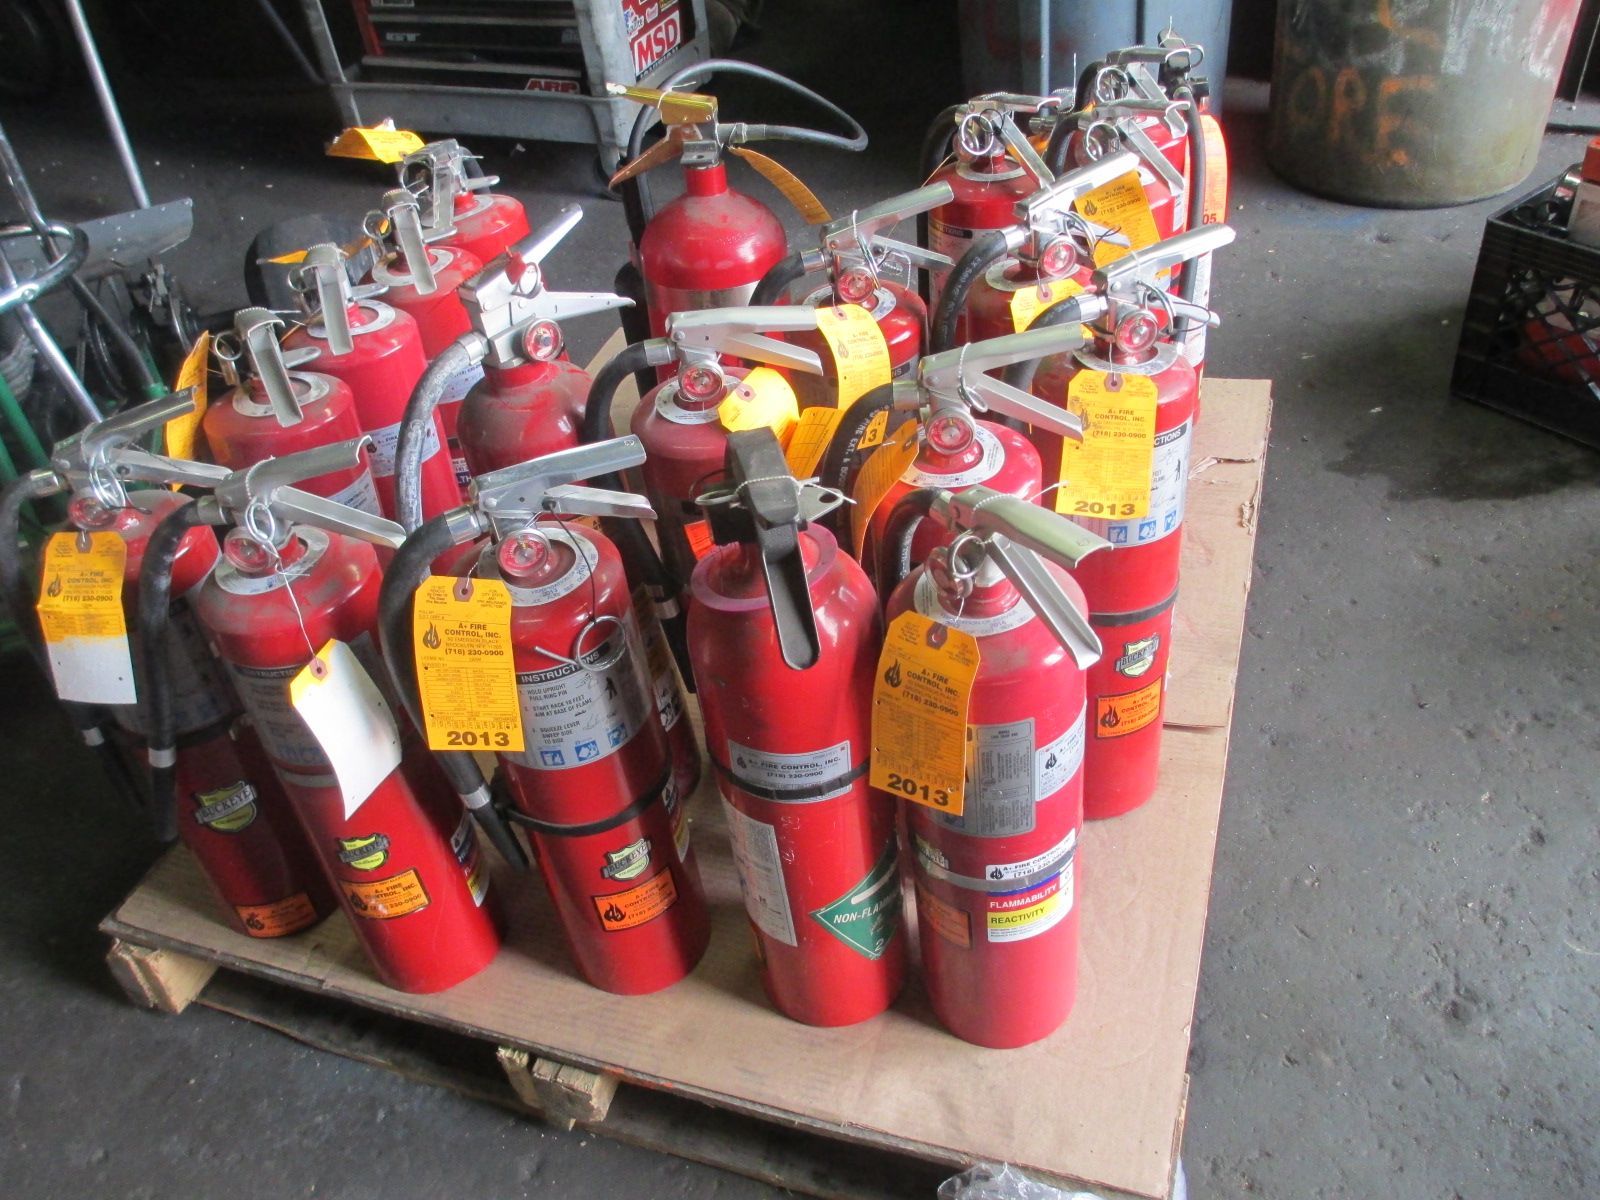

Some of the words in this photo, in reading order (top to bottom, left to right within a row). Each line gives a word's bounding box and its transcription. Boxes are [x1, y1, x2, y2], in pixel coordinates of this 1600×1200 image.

[637, 18, 678, 73] MSD
[1074, 500, 1136, 516] 2013
[445, 630, 484, 638] CONTROL,
[470, 623, 487, 631] FIRE
[906, 670, 943, 691] CONTROL,
[945, 685, 960, 698] INC.
[932, 672, 949, 684] FIRE
[923, 698, 959, 717] 230-0900
[446, 730, 510, 747] 2013
[760, 761, 779, 769] FIRE
[825, 756, 841, 766] INC.
[767, 771, 786, 779] (718)
[788, 770, 824, 779] 230-0900
[887, 773, 950, 807] 2013
[203, 788, 251, 818] BUCKEYE
[609, 845, 648, 873] BUCKEYE
[1014, 860, 1031, 869] FIRE
[386, 882, 403, 892] FIRE
[989, 883, 1057, 909] FLAMMABILITY
[990, 906, 1045, 925] REACTIVITY
[874, 938, 884, 952] 2
